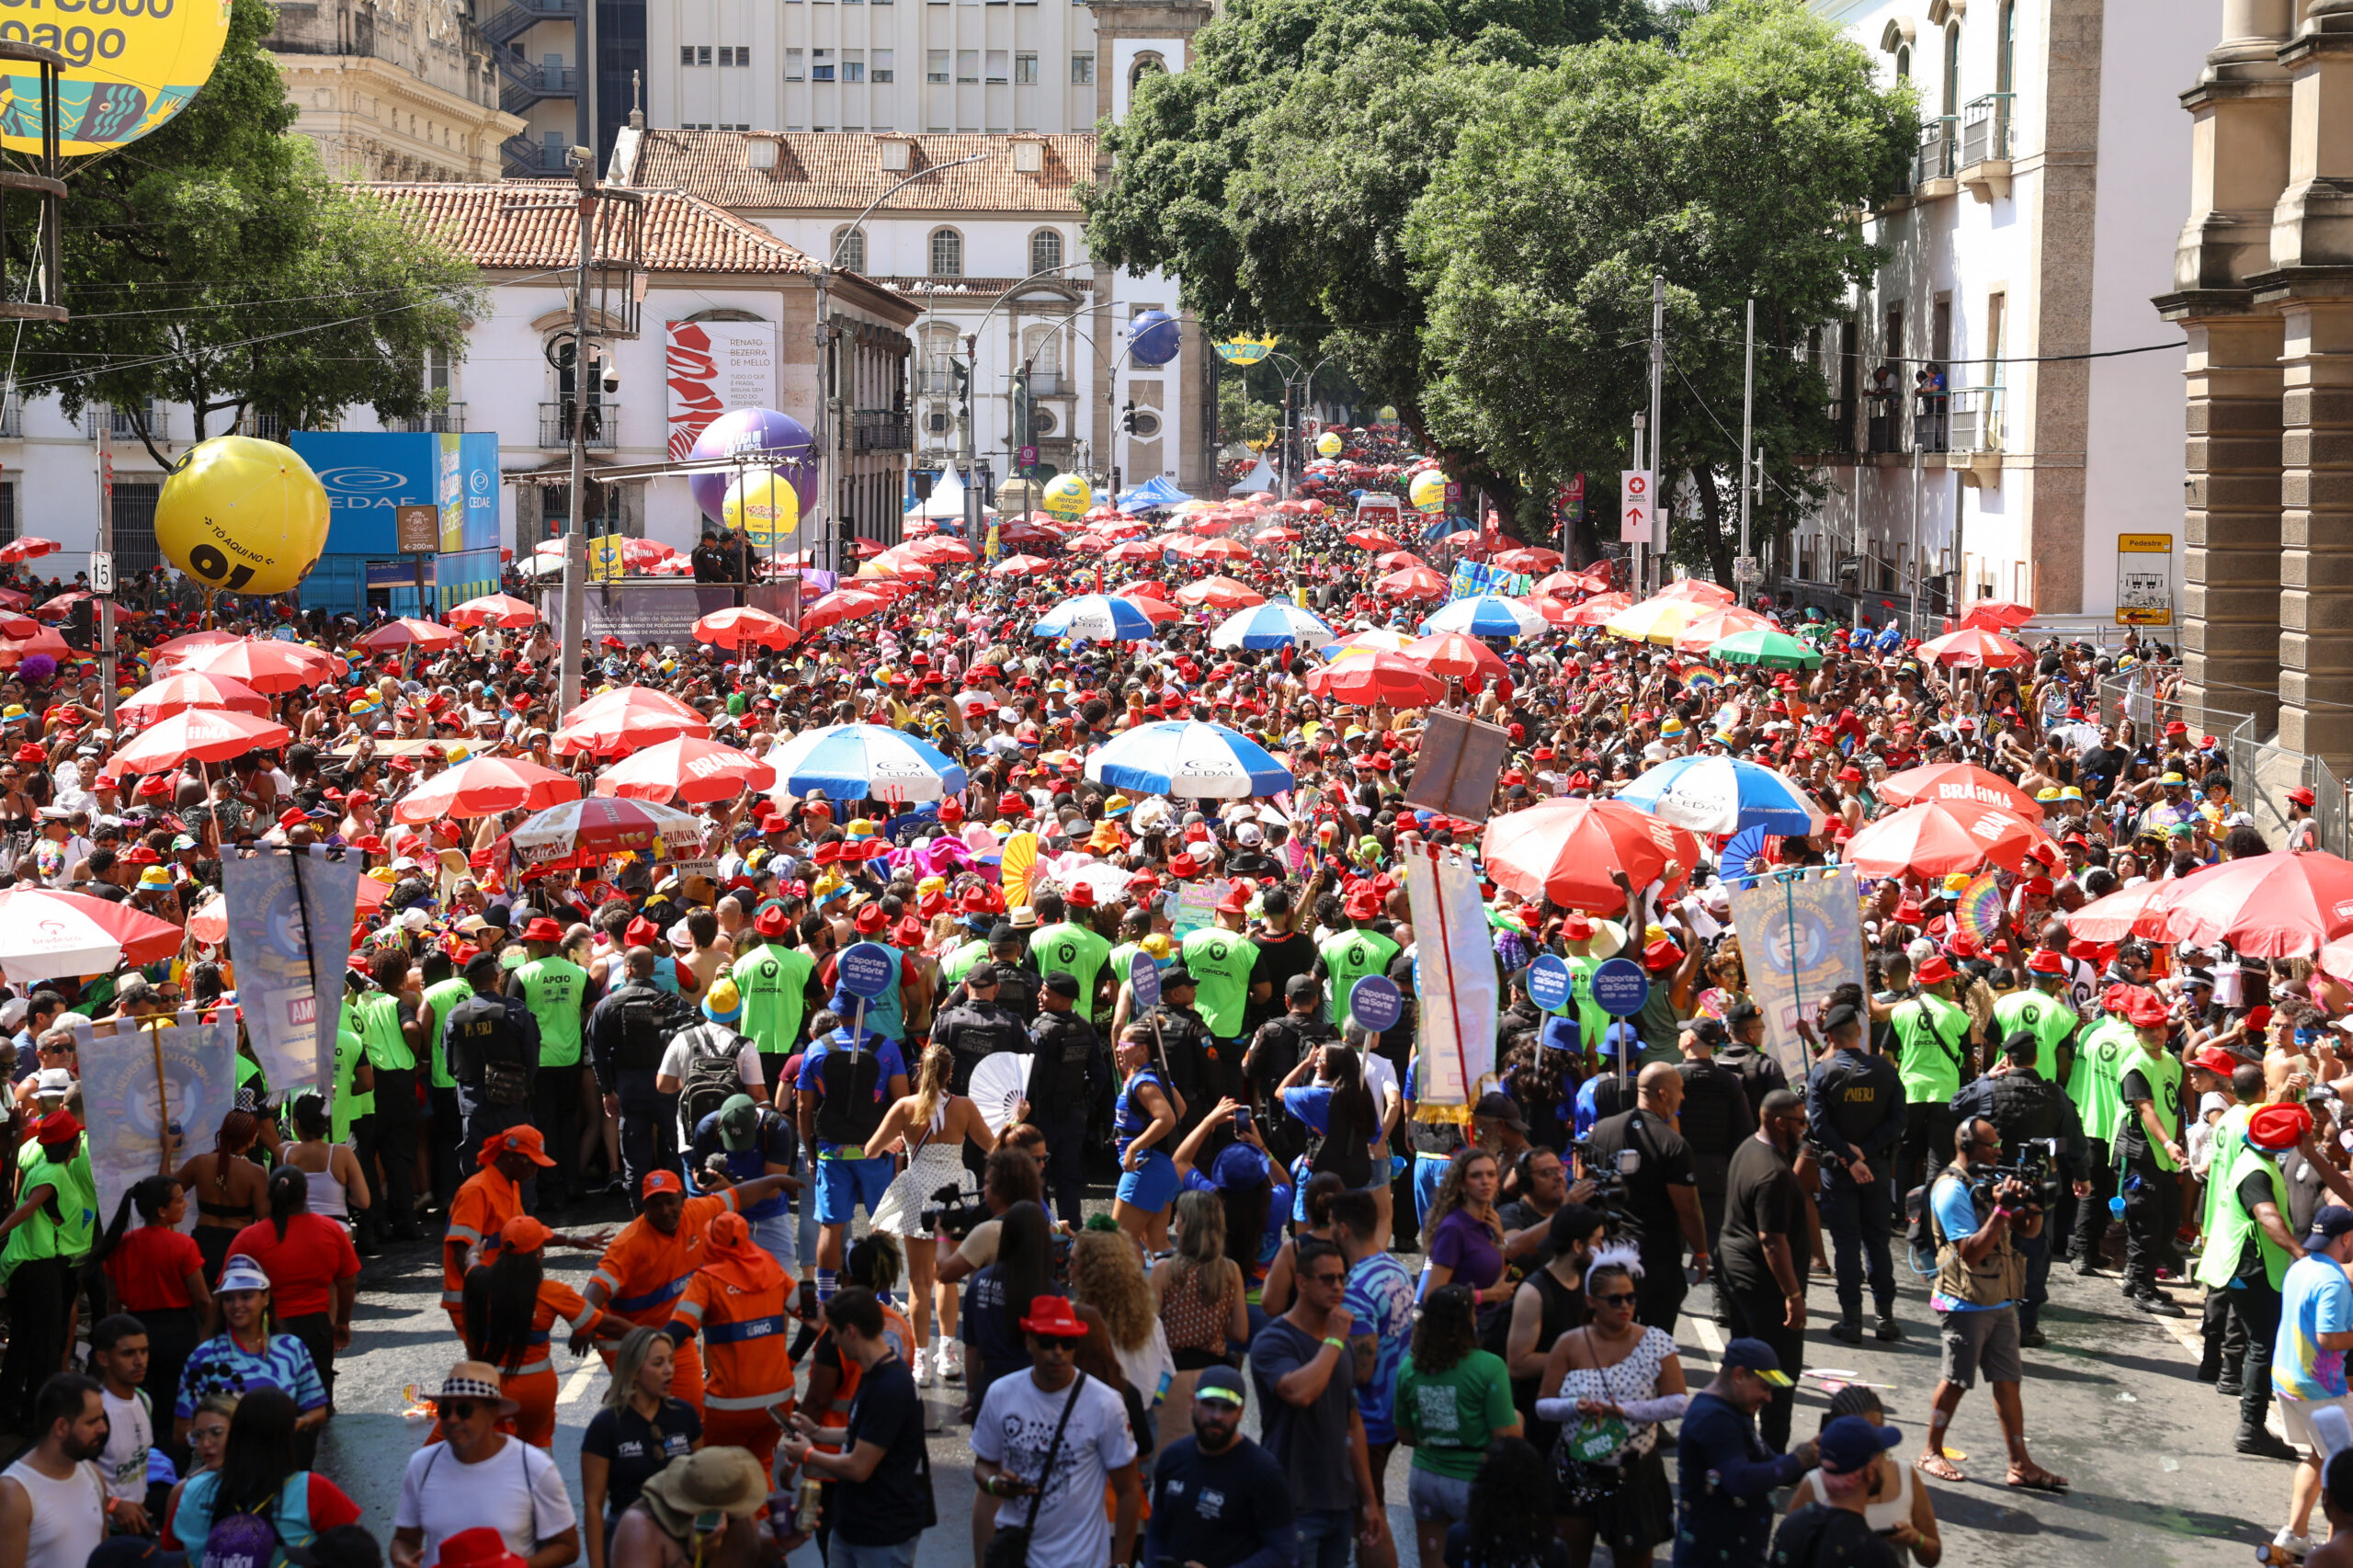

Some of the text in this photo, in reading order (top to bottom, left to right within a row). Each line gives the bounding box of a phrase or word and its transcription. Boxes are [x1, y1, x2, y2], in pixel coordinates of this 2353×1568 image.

[329, 497, 416, 509] EDAE
[469, 497, 491, 508] CEDAE
[1054, 496, 1085, 506] mercado
[1061, 503, 1078, 512] pago
[211, 526, 264, 563] TÔ AQUI NO
[2129, 540, 2162, 548] Pedestre
[94, 563, 109, 585] 15
[687, 752, 760, 778] BRAHMA
[1938, 782, 2013, 809] BRAHMA
[680, 861, 714, 869] ENTREGA
[31, 935, 82, 945] bradesco
[846, 955, 888, 969] Esportes
[860, 963, 885, 976] Sorte
[1532, 968, 1567, 983] Esportes
[542, 974, 571, 984] APOIO
[1542, 976, 1564, 990] Sorte
[1574, 973, 1593, 983] POI
[1597, 974, 1642, 984] Esportes
[1612, 983, 1640, 992] Sorte
[1357, 987, 1397, 1003] Esportes
[1370, 997, 1393, 1011] Sorte
[753, 1322, 772, 1335] RIO
